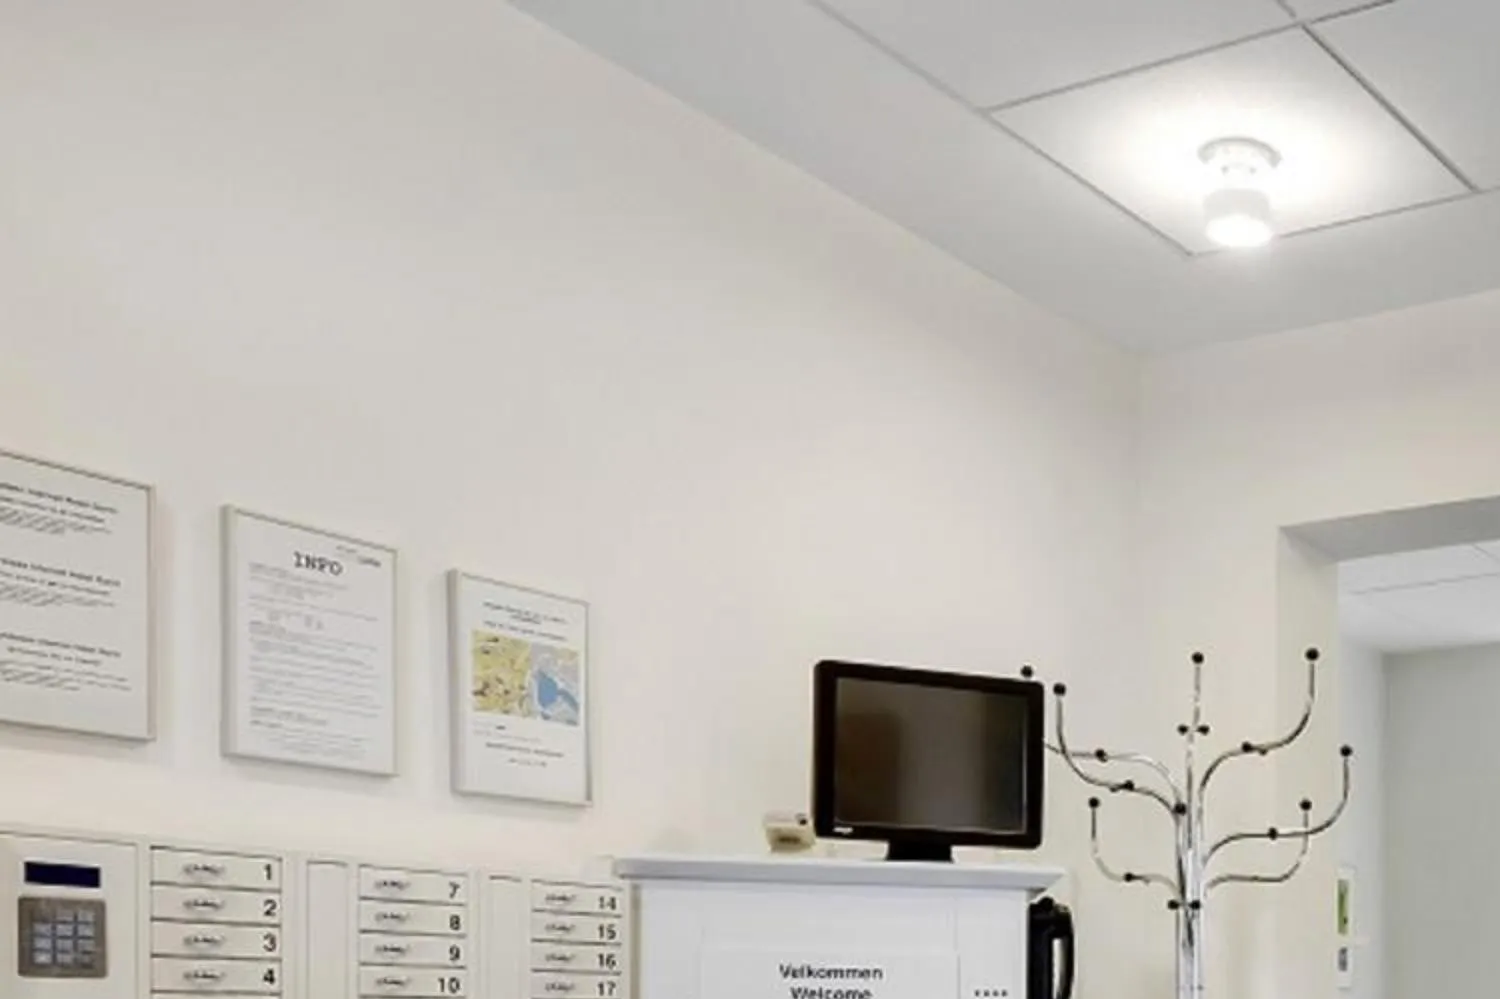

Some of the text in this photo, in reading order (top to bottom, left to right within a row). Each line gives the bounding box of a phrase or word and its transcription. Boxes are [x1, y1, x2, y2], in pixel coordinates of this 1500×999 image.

[293, 550, 344, 576] INFO
[264, 862, 273, 880] 1
[449, 882, 460, 899] 7
[264, 899, 277, 917] 2
[598, 896, 617, 911] 14
[450, 914, 461, 931] 8
[598, 924, 617, 940] 15
[263, 933, 277, 952] 3
[449, 944, 461, 962] 9
[598, 953, 617, 970] 16
[263, 968, 277, 986] 4
[779, 963, 884, 979] Velkommen
[438, 976, 461, 994] 10
[598, 980, 617, 997] 17
